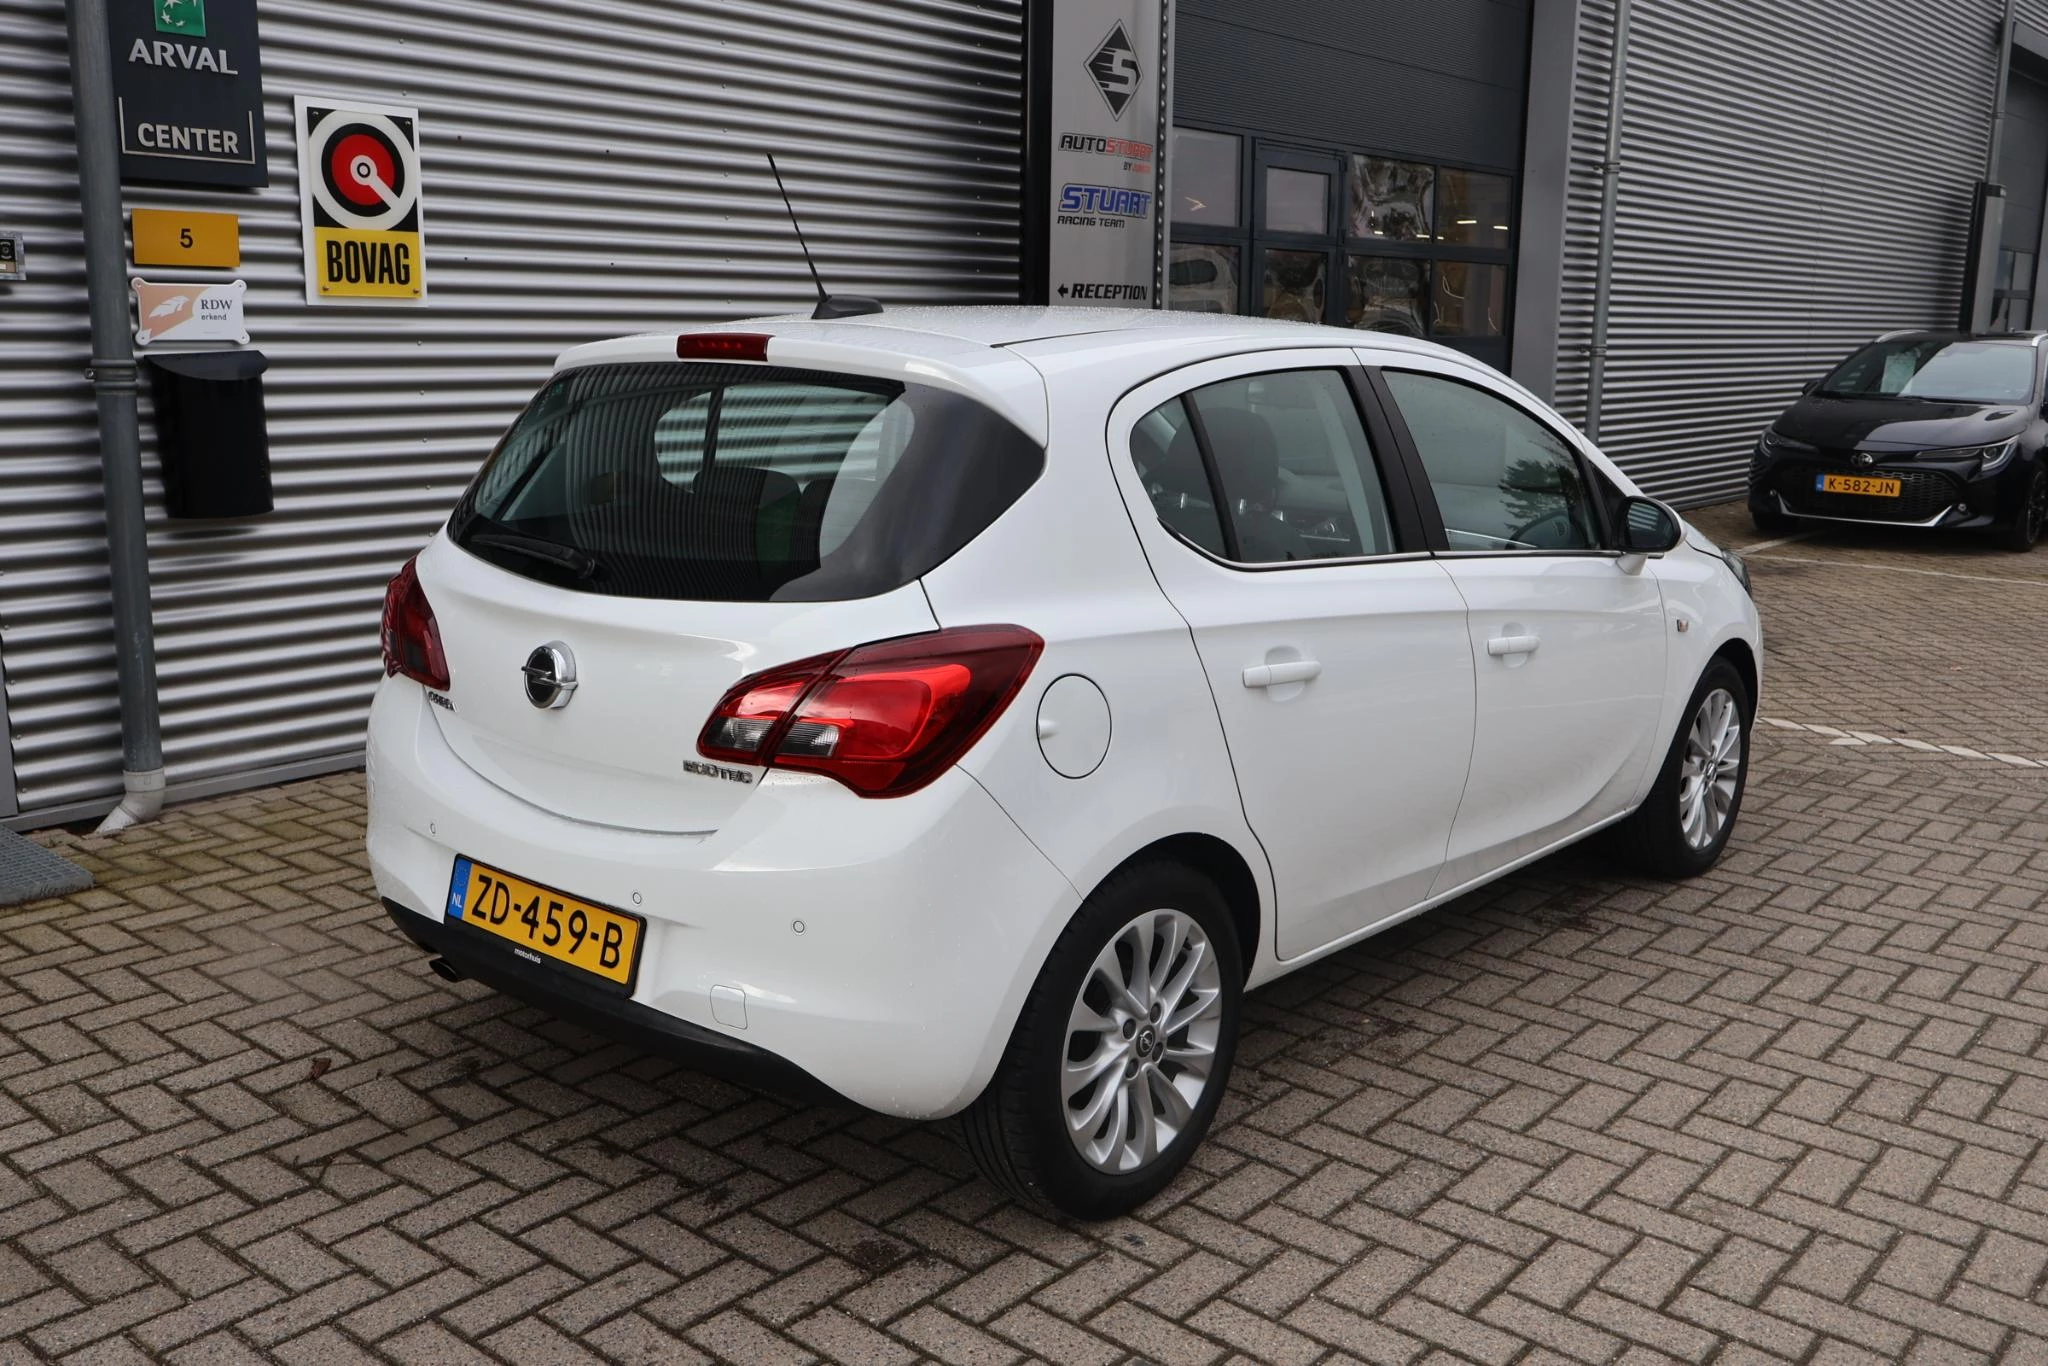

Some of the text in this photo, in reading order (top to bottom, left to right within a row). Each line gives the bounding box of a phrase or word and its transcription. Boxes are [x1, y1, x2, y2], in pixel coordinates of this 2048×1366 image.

[129, 38, 238, 76] ARVAL
[137, 122, 239, 154] CENTER
[1058, 183, 1152, 219] STUART
[1057, 215, 1125, 229] RACING TEAM
[180, 228, 193, 249] 5
[326, 240, 410, 286] BOVAG
[1071, 283, 1147, 301] RECEPTION
[201, 299, 233, 311] RDW
[201, 313, 227, 321] erkend
[1828, 477, 1895, 494] K-582-JN
[452, 893, 462, 908] NL
[471, 873, 623, 969] ZD-459-B
